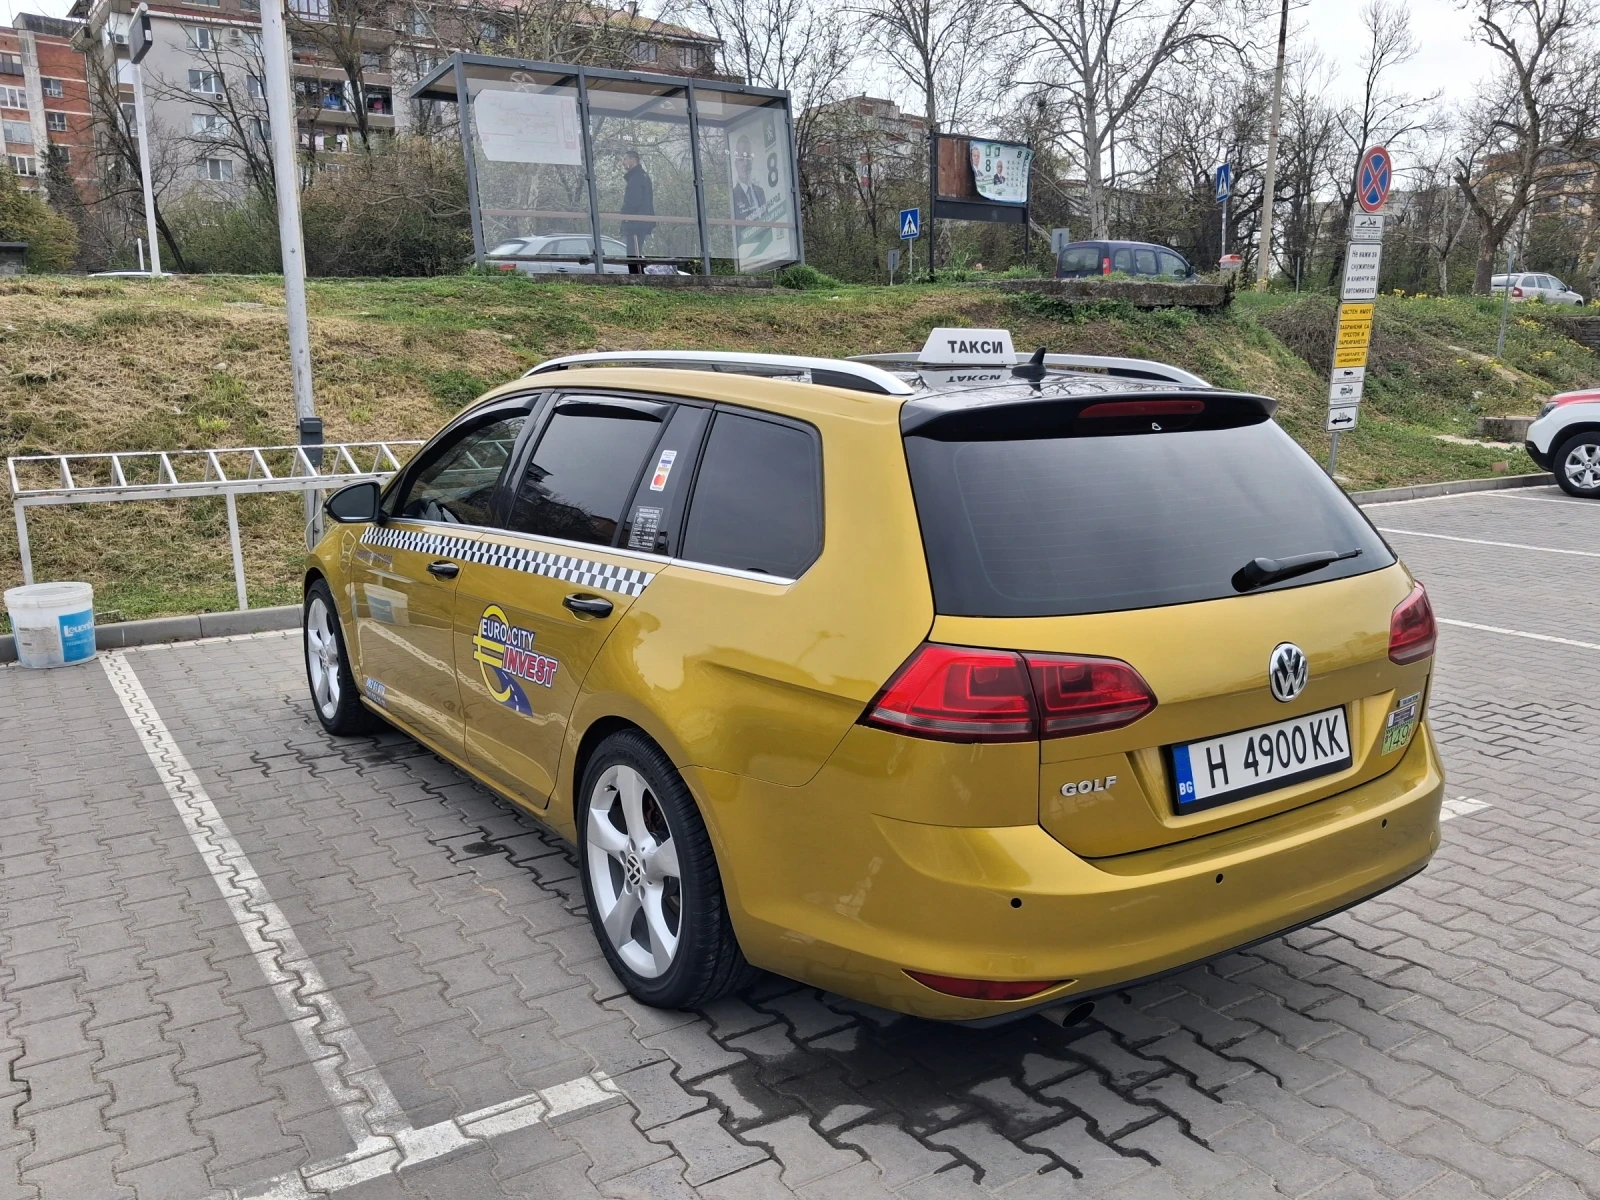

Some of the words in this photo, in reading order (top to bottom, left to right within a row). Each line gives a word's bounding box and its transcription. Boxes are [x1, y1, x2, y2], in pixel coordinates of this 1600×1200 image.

[767, 152, 779, 188] 8
[985, 159, 991, 172] 8
[1351, 264, 1375, 272] служители
[947, 340, 1003, 354] ТАКСИ
[482, 618, 507, 642] EURO
[511, 626, 535, 651] CITY
[502, 644, 558, 688] INVEST
[1205, 743, 1230, 789] H
[1243, 725, 1307, 777] 4900
[1308, 714, 1344, 761] KK
[1060, 775, 1117, 797] GOLF
[1178, 780, 1194, 796] BG
